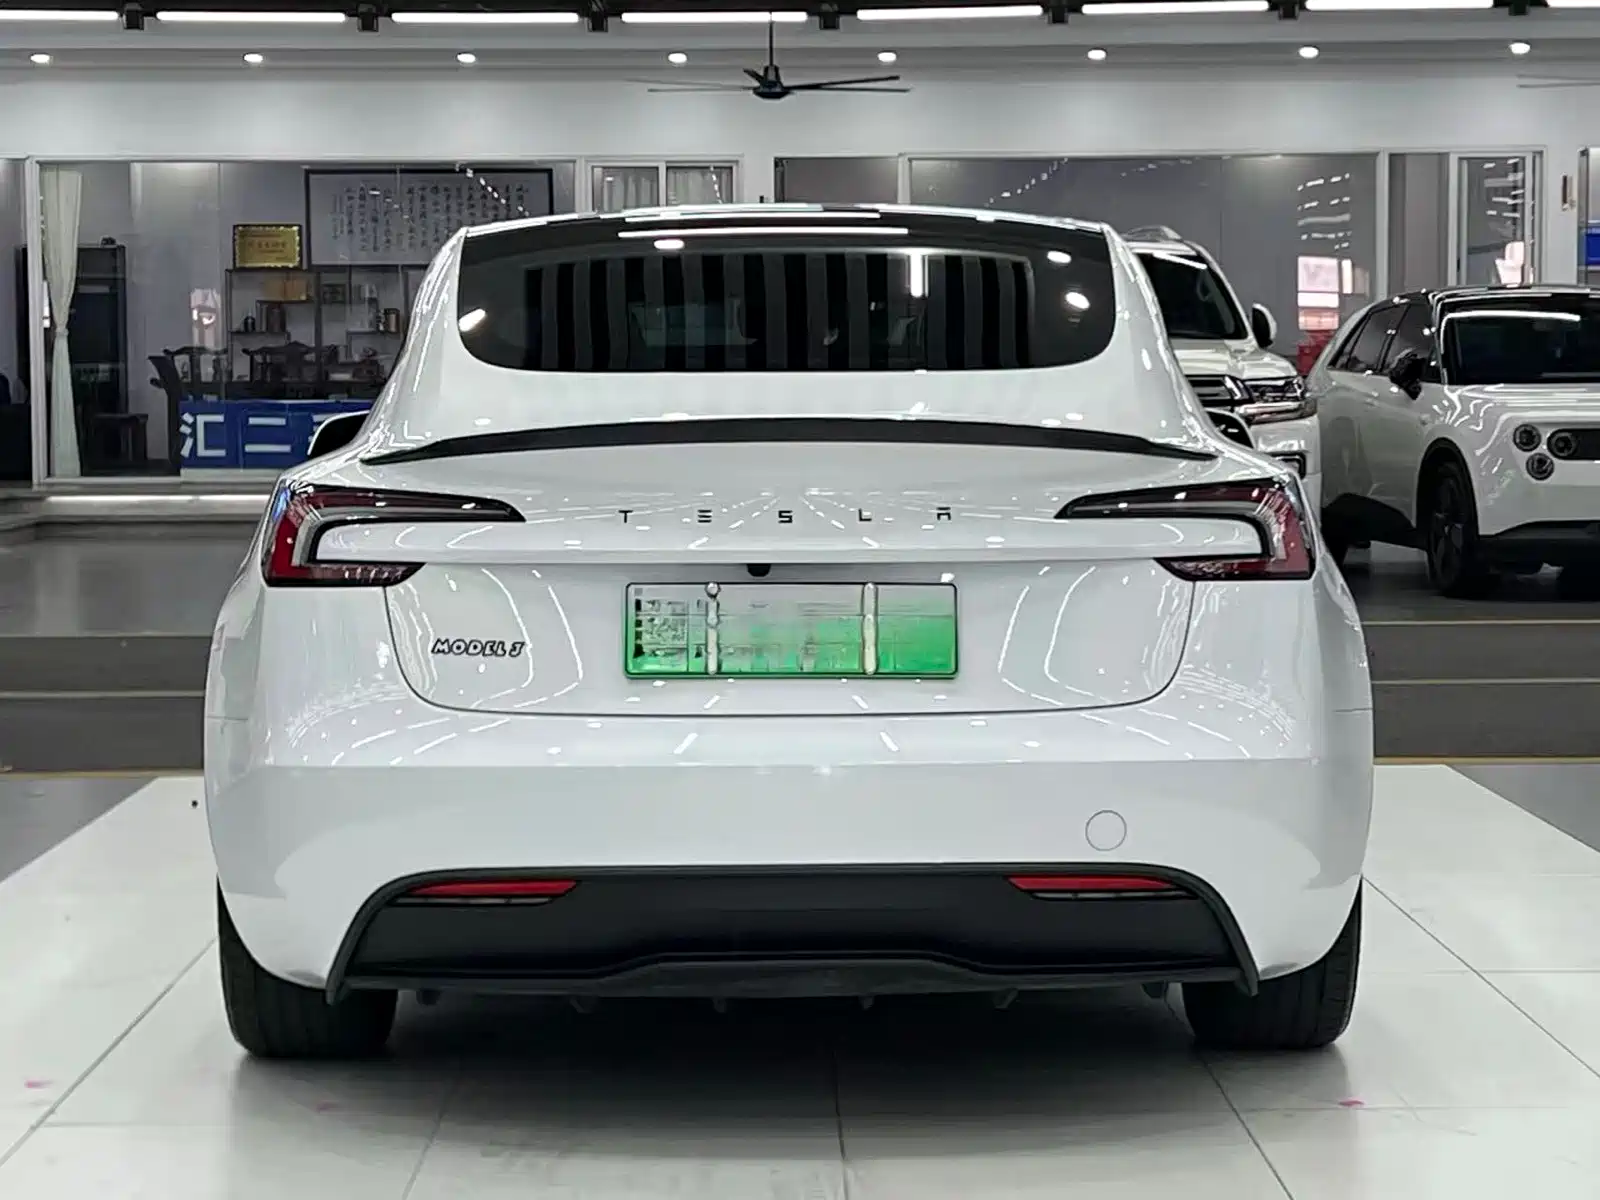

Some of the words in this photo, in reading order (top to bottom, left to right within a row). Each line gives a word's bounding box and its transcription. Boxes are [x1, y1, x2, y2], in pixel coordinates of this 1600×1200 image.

[179, 412, 334, 458] 汇二
[618, 506, 952, 524] TESLA
[431, 638, 507, 657] MODEL
